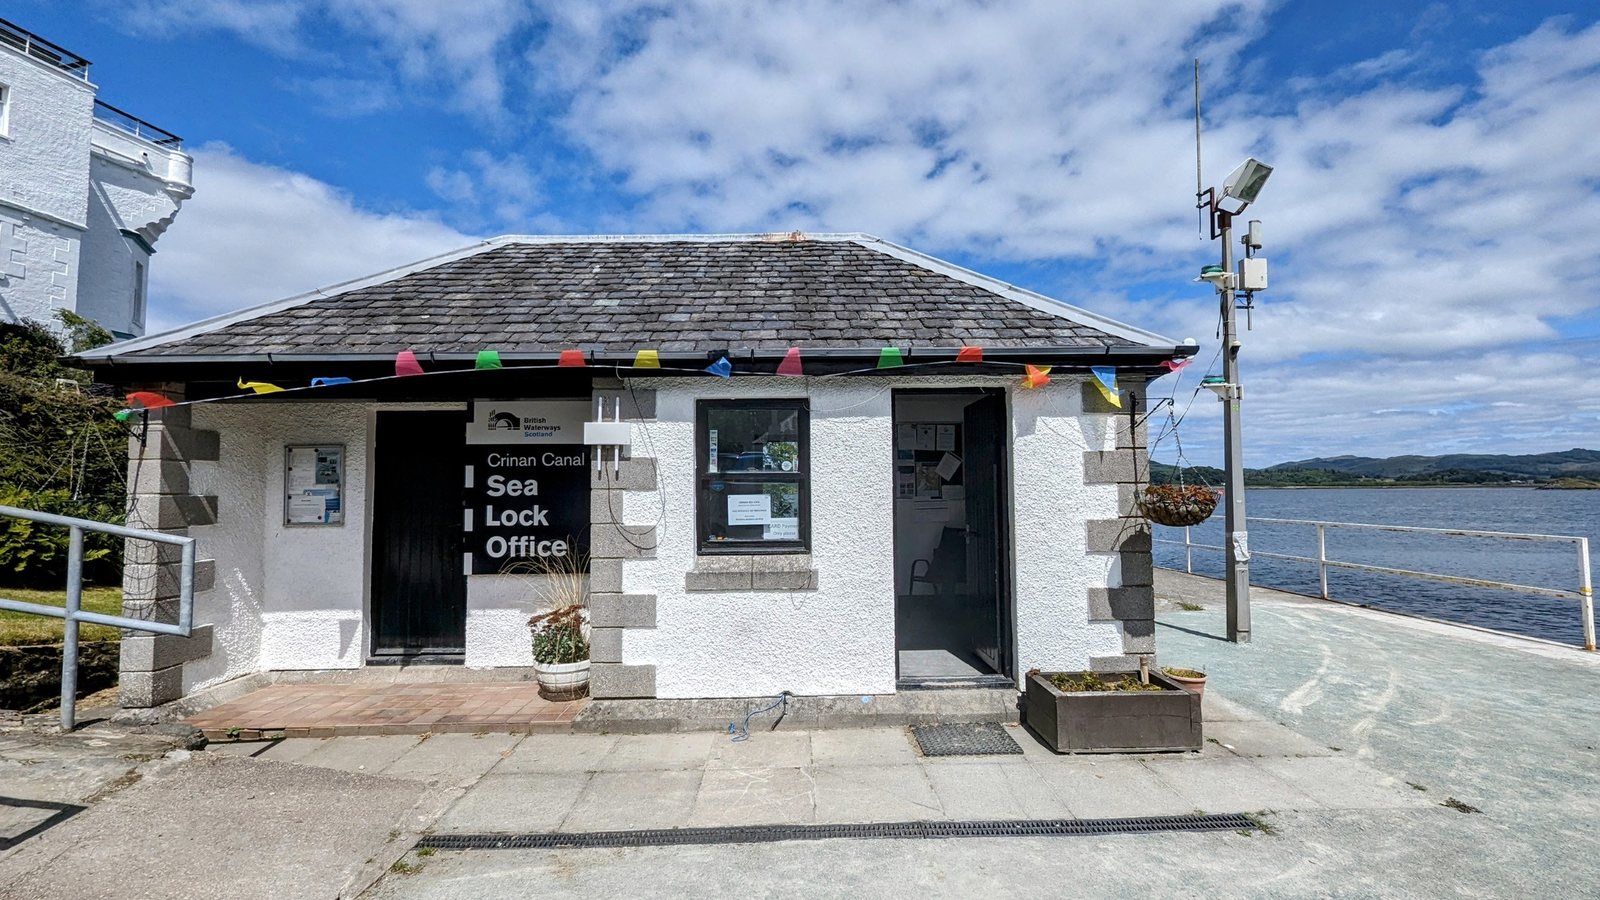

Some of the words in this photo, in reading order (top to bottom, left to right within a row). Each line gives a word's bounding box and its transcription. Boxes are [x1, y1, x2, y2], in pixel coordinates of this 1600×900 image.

[524, 424, 561, 432] Waterways
[487, 453, 537, 467] Crinan
[542, 452, 585, 467] Canal
[486, 475, 538, 497] Sea
[486, 505, 549, 527] Lock
[486, 536, 568, 558] Office
